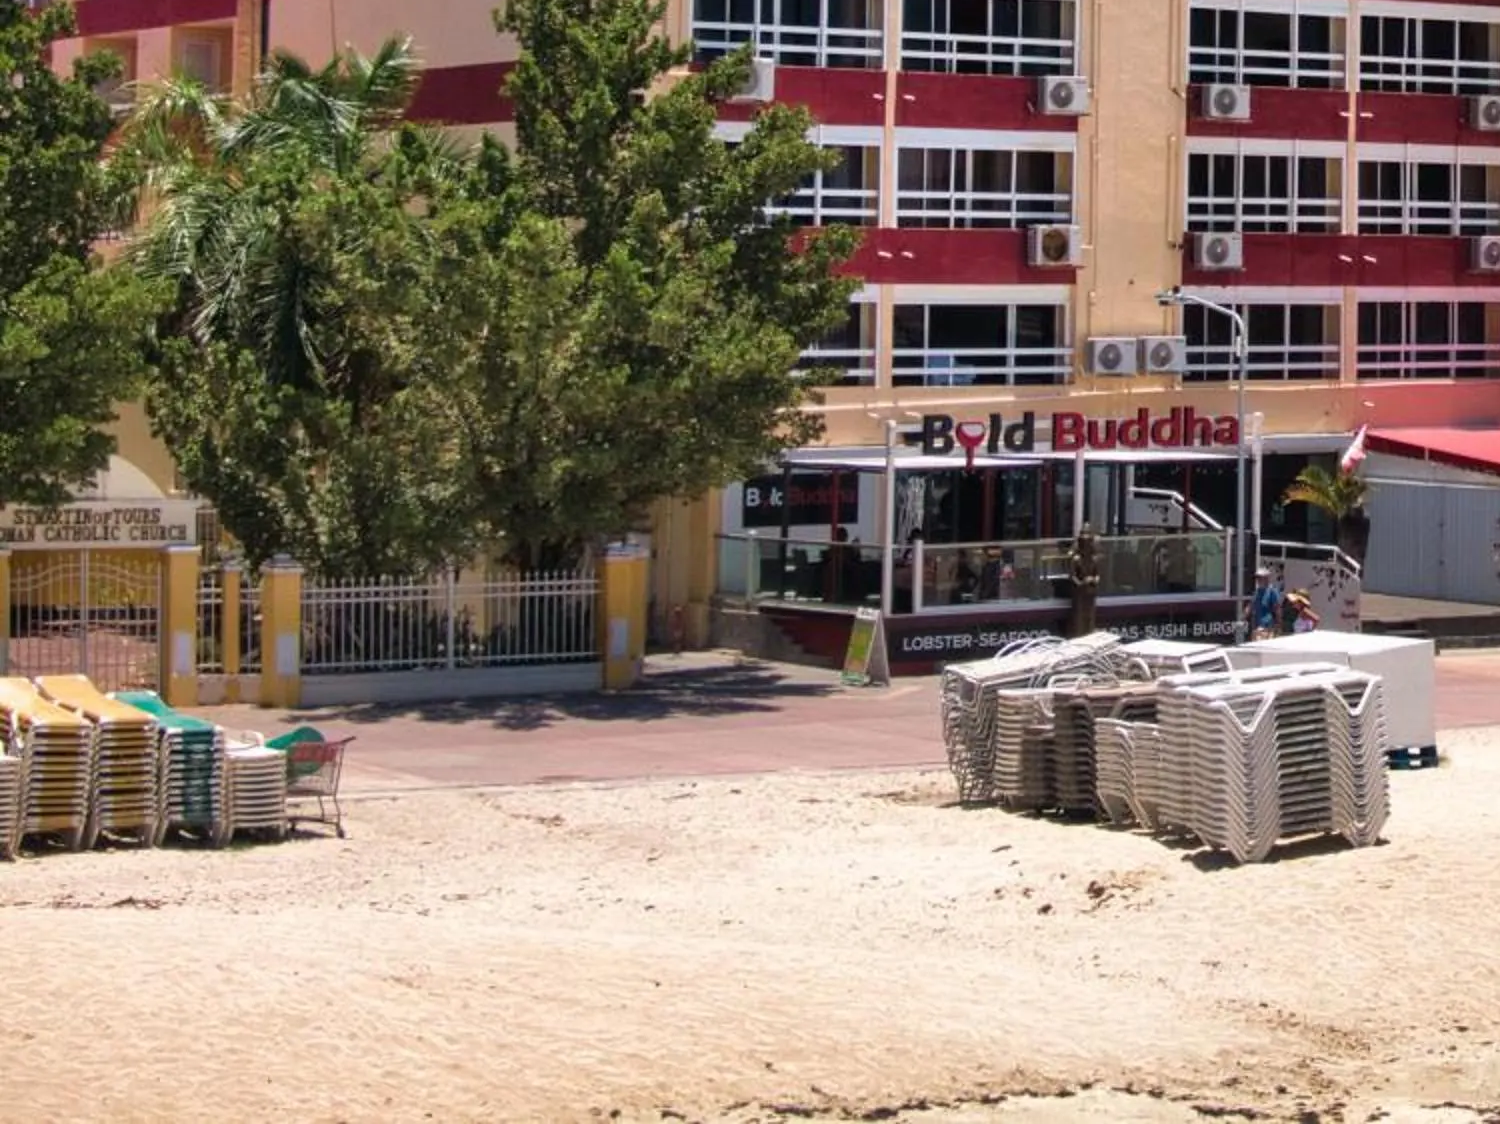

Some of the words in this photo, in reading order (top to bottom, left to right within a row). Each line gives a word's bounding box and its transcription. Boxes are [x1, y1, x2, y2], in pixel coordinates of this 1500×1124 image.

[1052, 405, 1239, 452] Buddha
[44, 526, 122, 542] CATHOLIC
[129, 524, 187, 541] CHURCH
